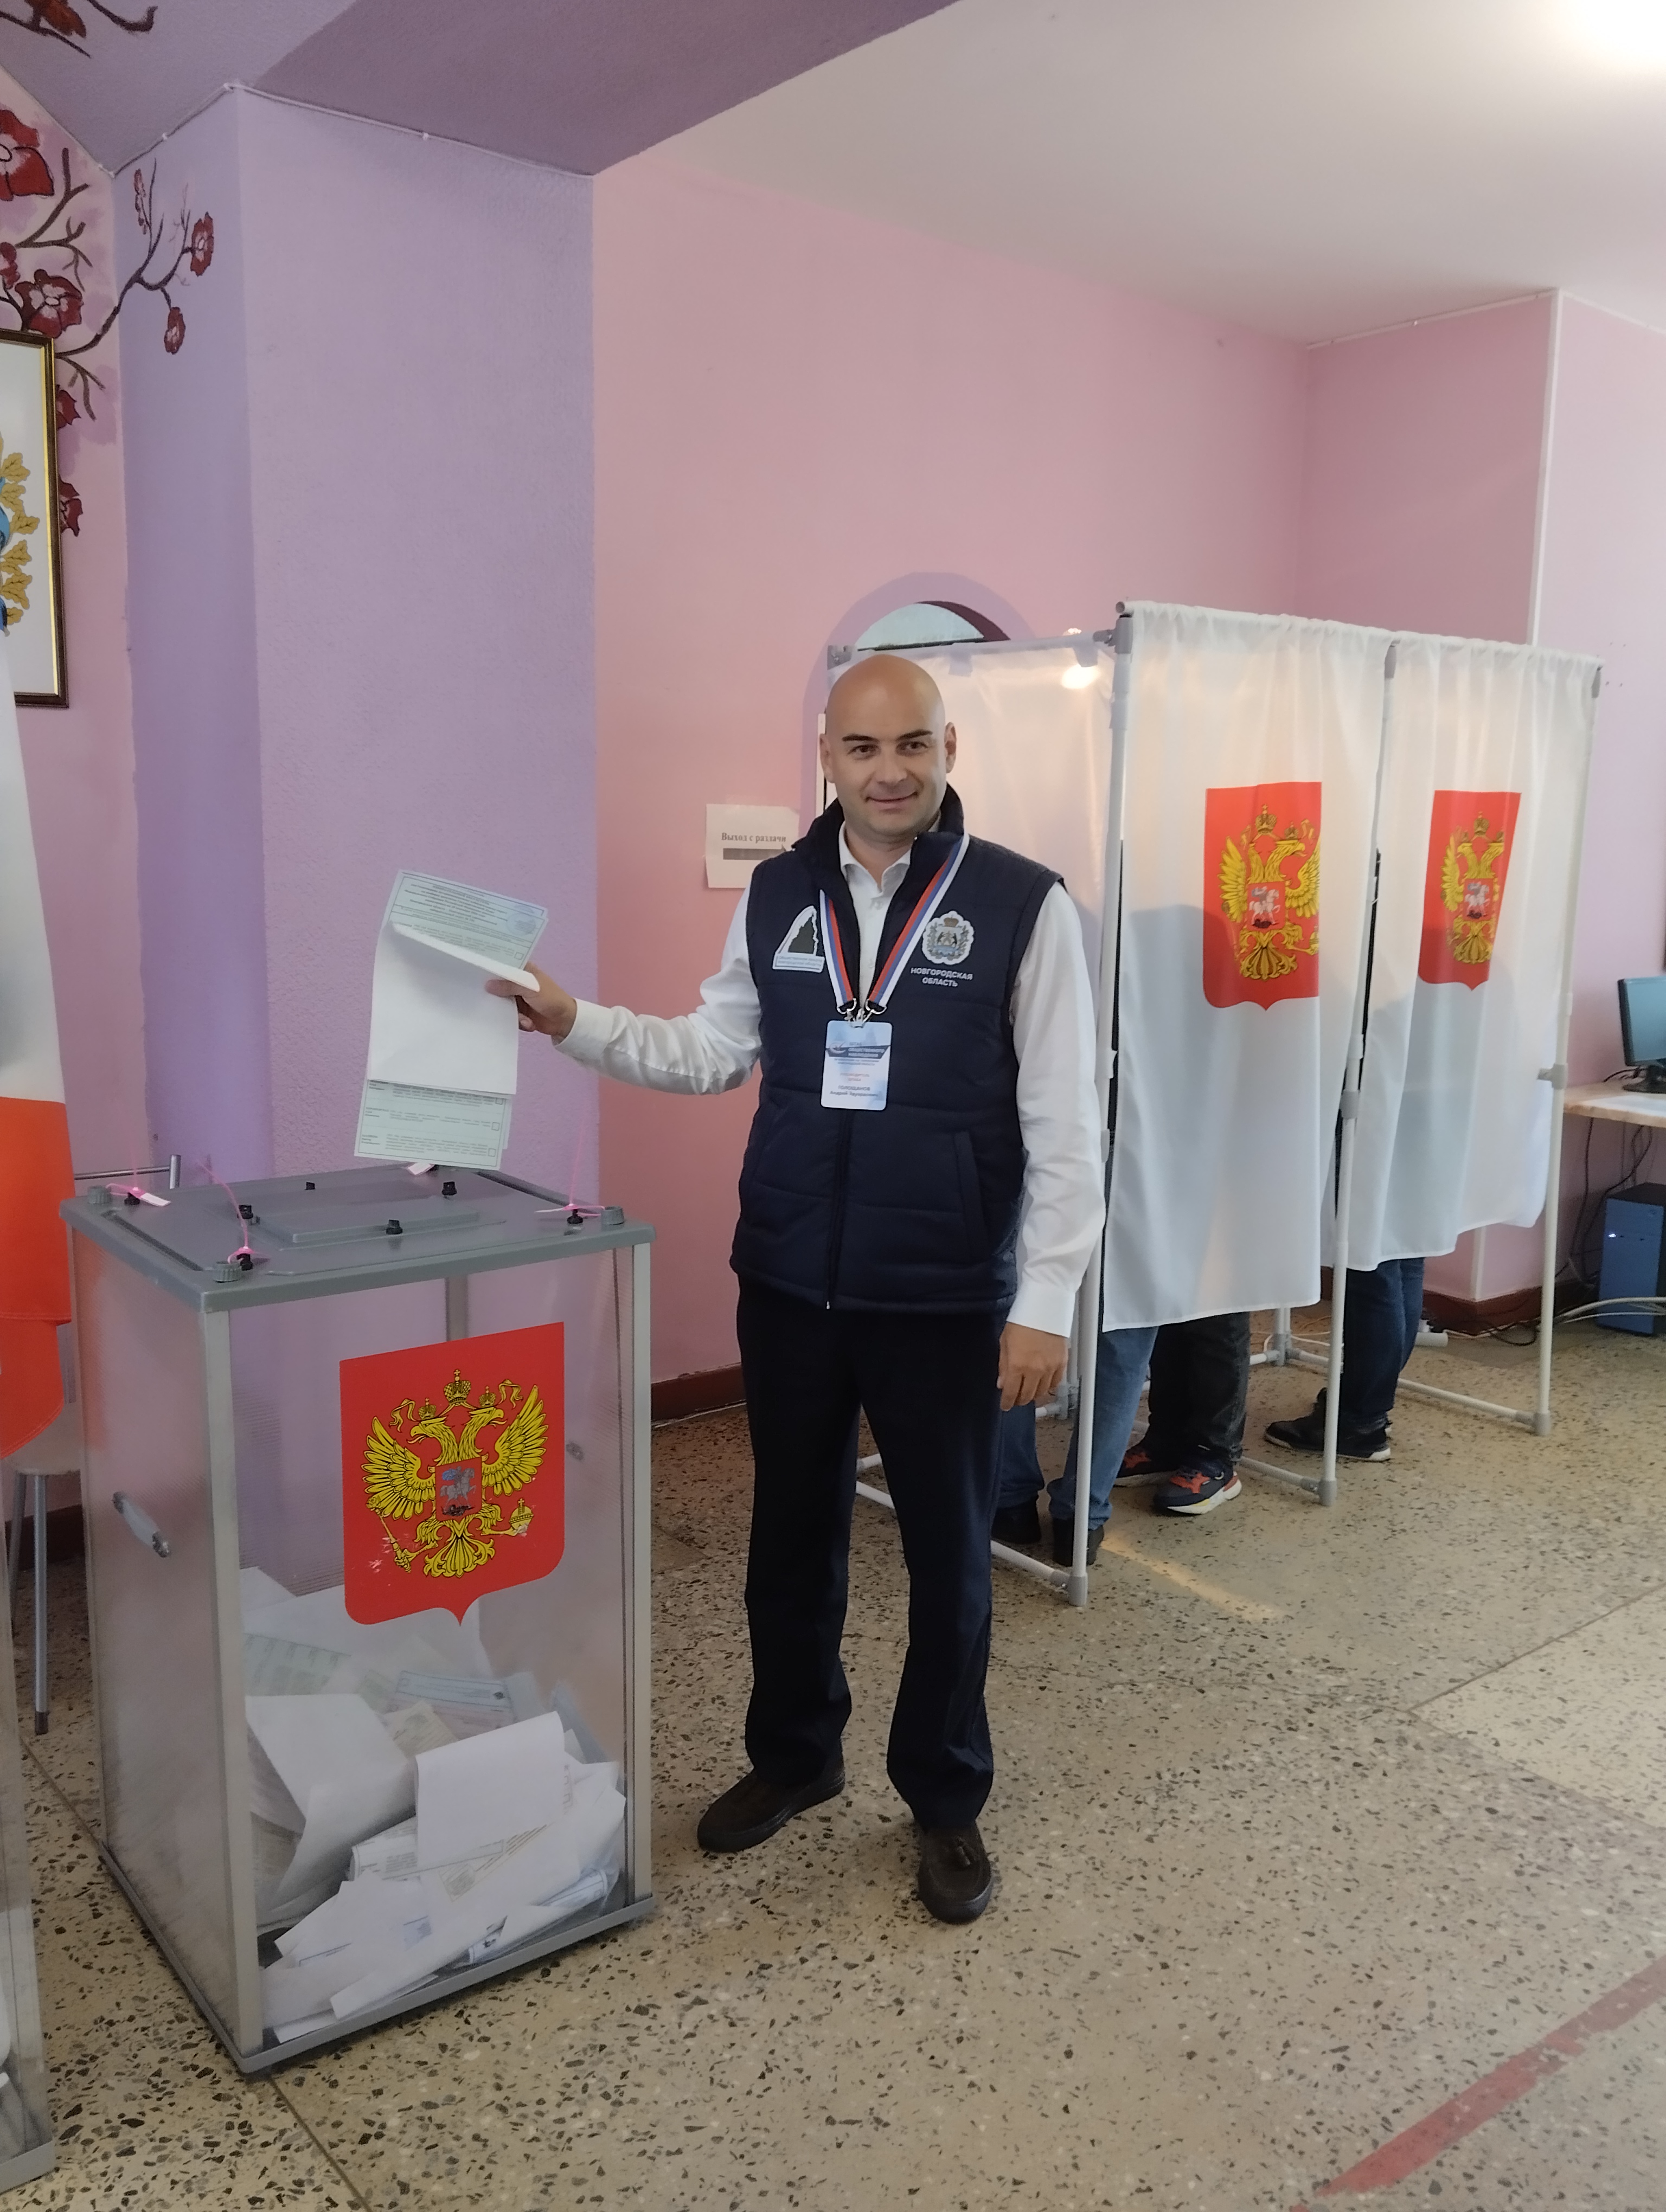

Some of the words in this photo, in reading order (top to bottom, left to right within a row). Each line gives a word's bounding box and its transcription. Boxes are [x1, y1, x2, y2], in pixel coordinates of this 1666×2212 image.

[721, 832, 747, 841] Выход
[911, 968, 973, 980] НОВГОРОДСКАЯ
[922, 977, 958, 987] ОБЛАСТЬ
